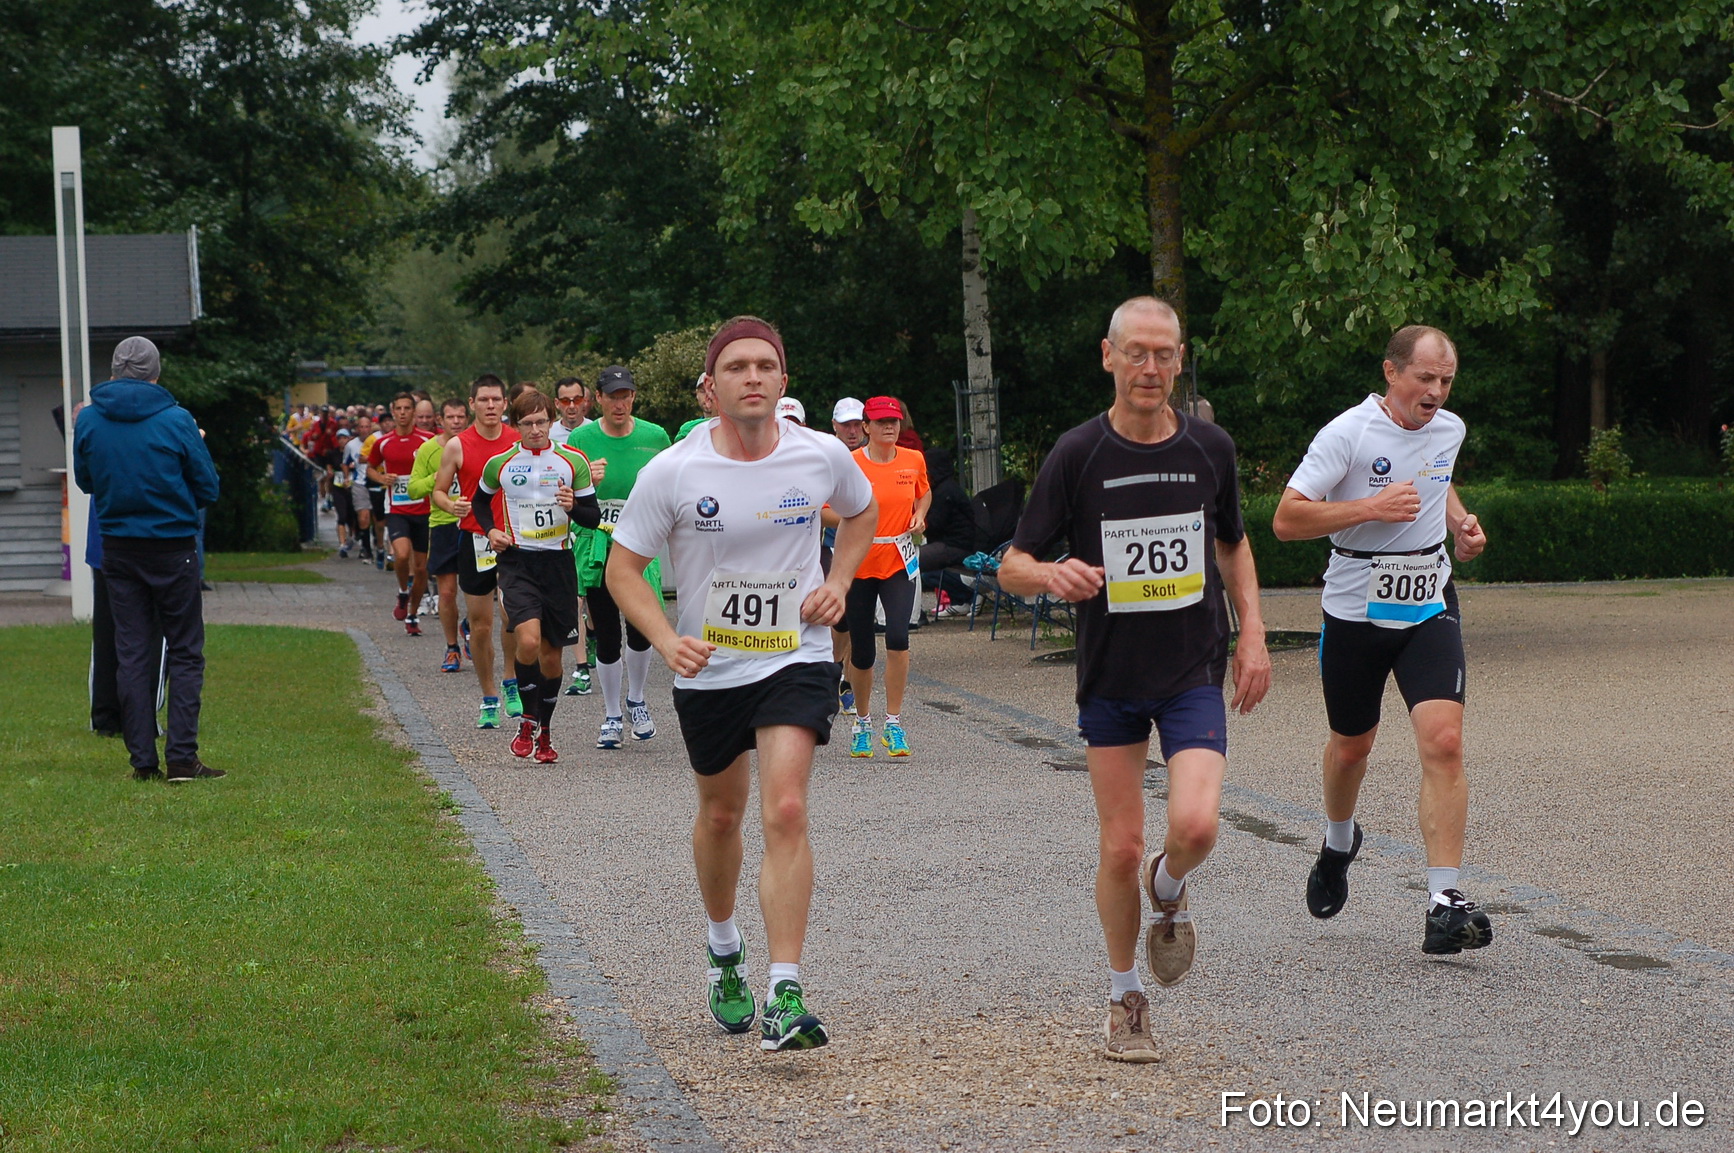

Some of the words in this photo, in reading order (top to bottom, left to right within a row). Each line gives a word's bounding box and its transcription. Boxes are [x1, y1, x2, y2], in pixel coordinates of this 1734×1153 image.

[394, 483, 409, 493] 25
[535, 508, 554, 527] 61
[535, 529, 556, 539] Daniel
[1104, 528, 1138, 539] PARTL
[1141, 524, 1188, 536] Neumarkt
[902, 541, 916, 561] 22
[1125, 538, 1188, 576] 263
[1378, 562, 1401, 571] ARTL
[1403, 561, 1436, 571] Neumarkt
[711, 580, 738, 589] ARTL
[740, 580, 785, 589] Neumarkt
[1142, 583, 1176, 598] Skott
[1377, 573, 1438, 602] 3083
[721, 593, 779, 627] 491
[707, 630, 793, 649] Hans-Christof
